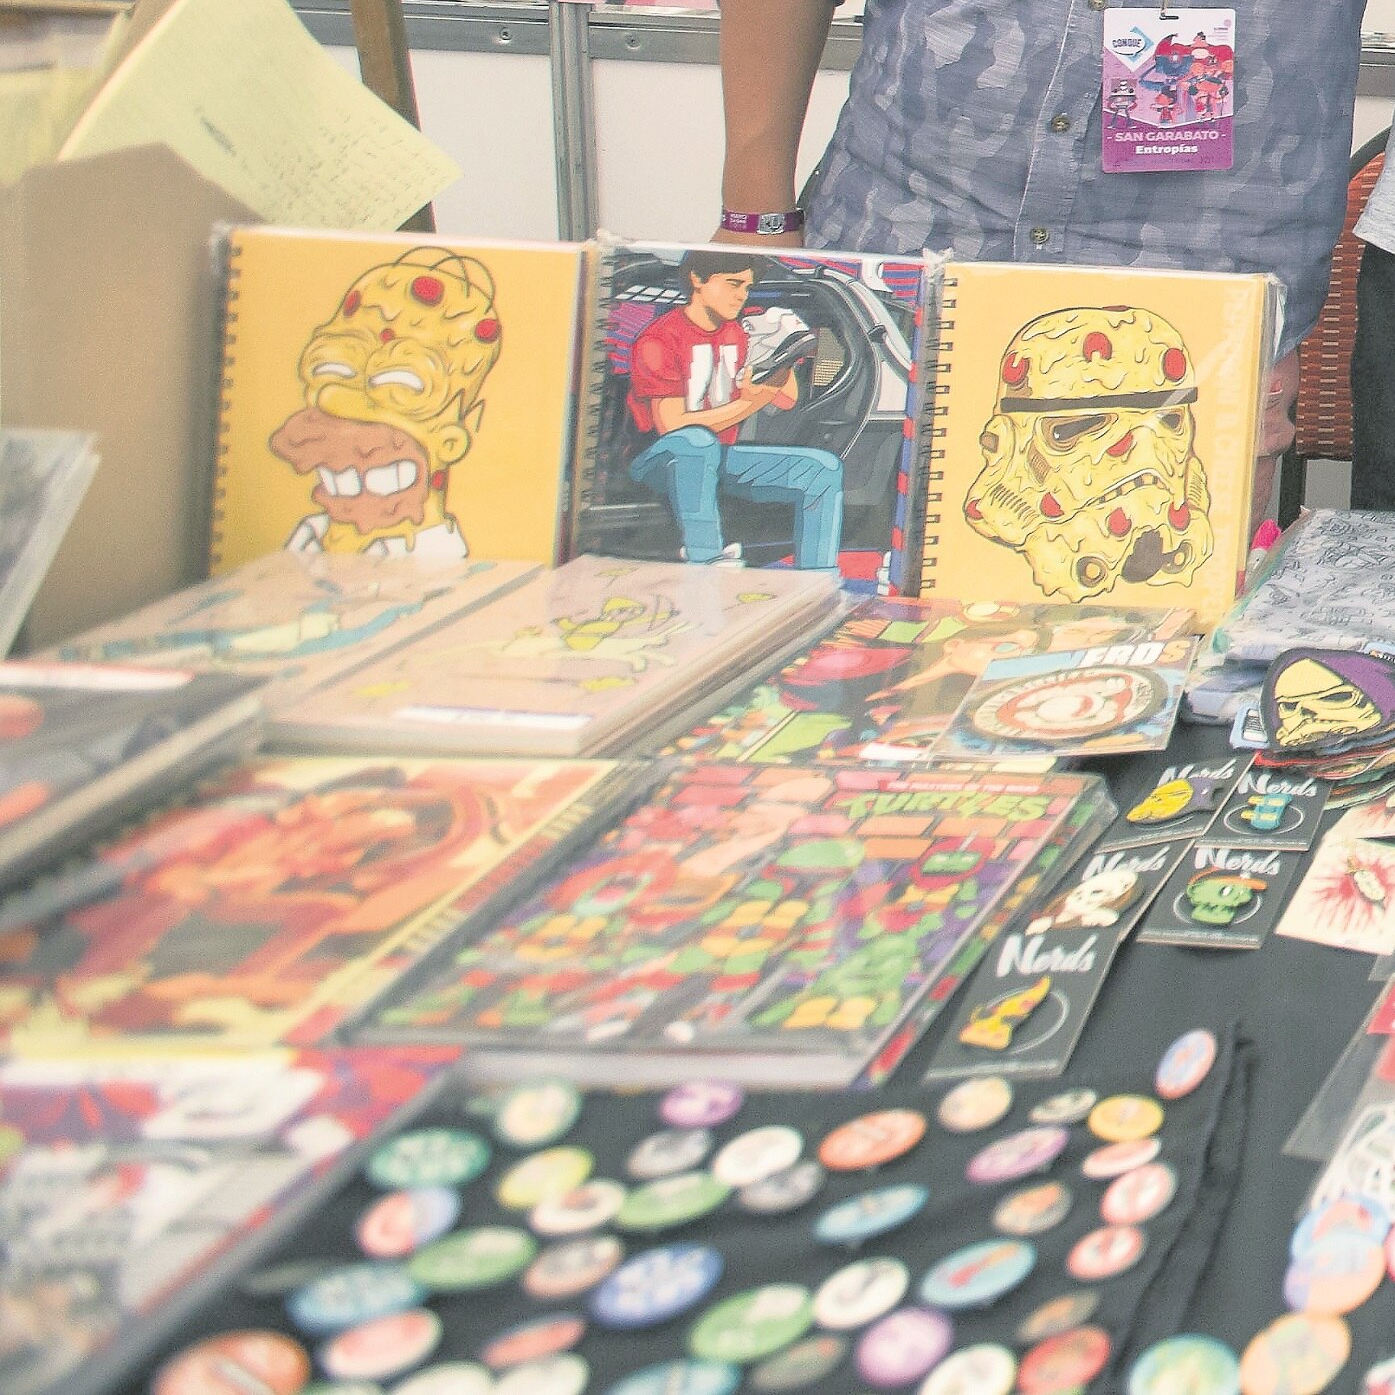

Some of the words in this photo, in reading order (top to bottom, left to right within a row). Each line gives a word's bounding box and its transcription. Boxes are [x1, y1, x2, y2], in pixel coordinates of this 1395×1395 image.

[1112, 37, 1142, 49] CONQUE
[1115, 131, 1143, 142] SAN
[1145, 130, 1219, 141] GARABATO
[1135, 143, 1198, 155] Entropías
[1238, 772, 1318, 800] Nerds
[835, 791, 1048, 822] TURTLES
[1193, 846, 1281, 877] Nerds
[996, 932, 1097, 978] Nerds
